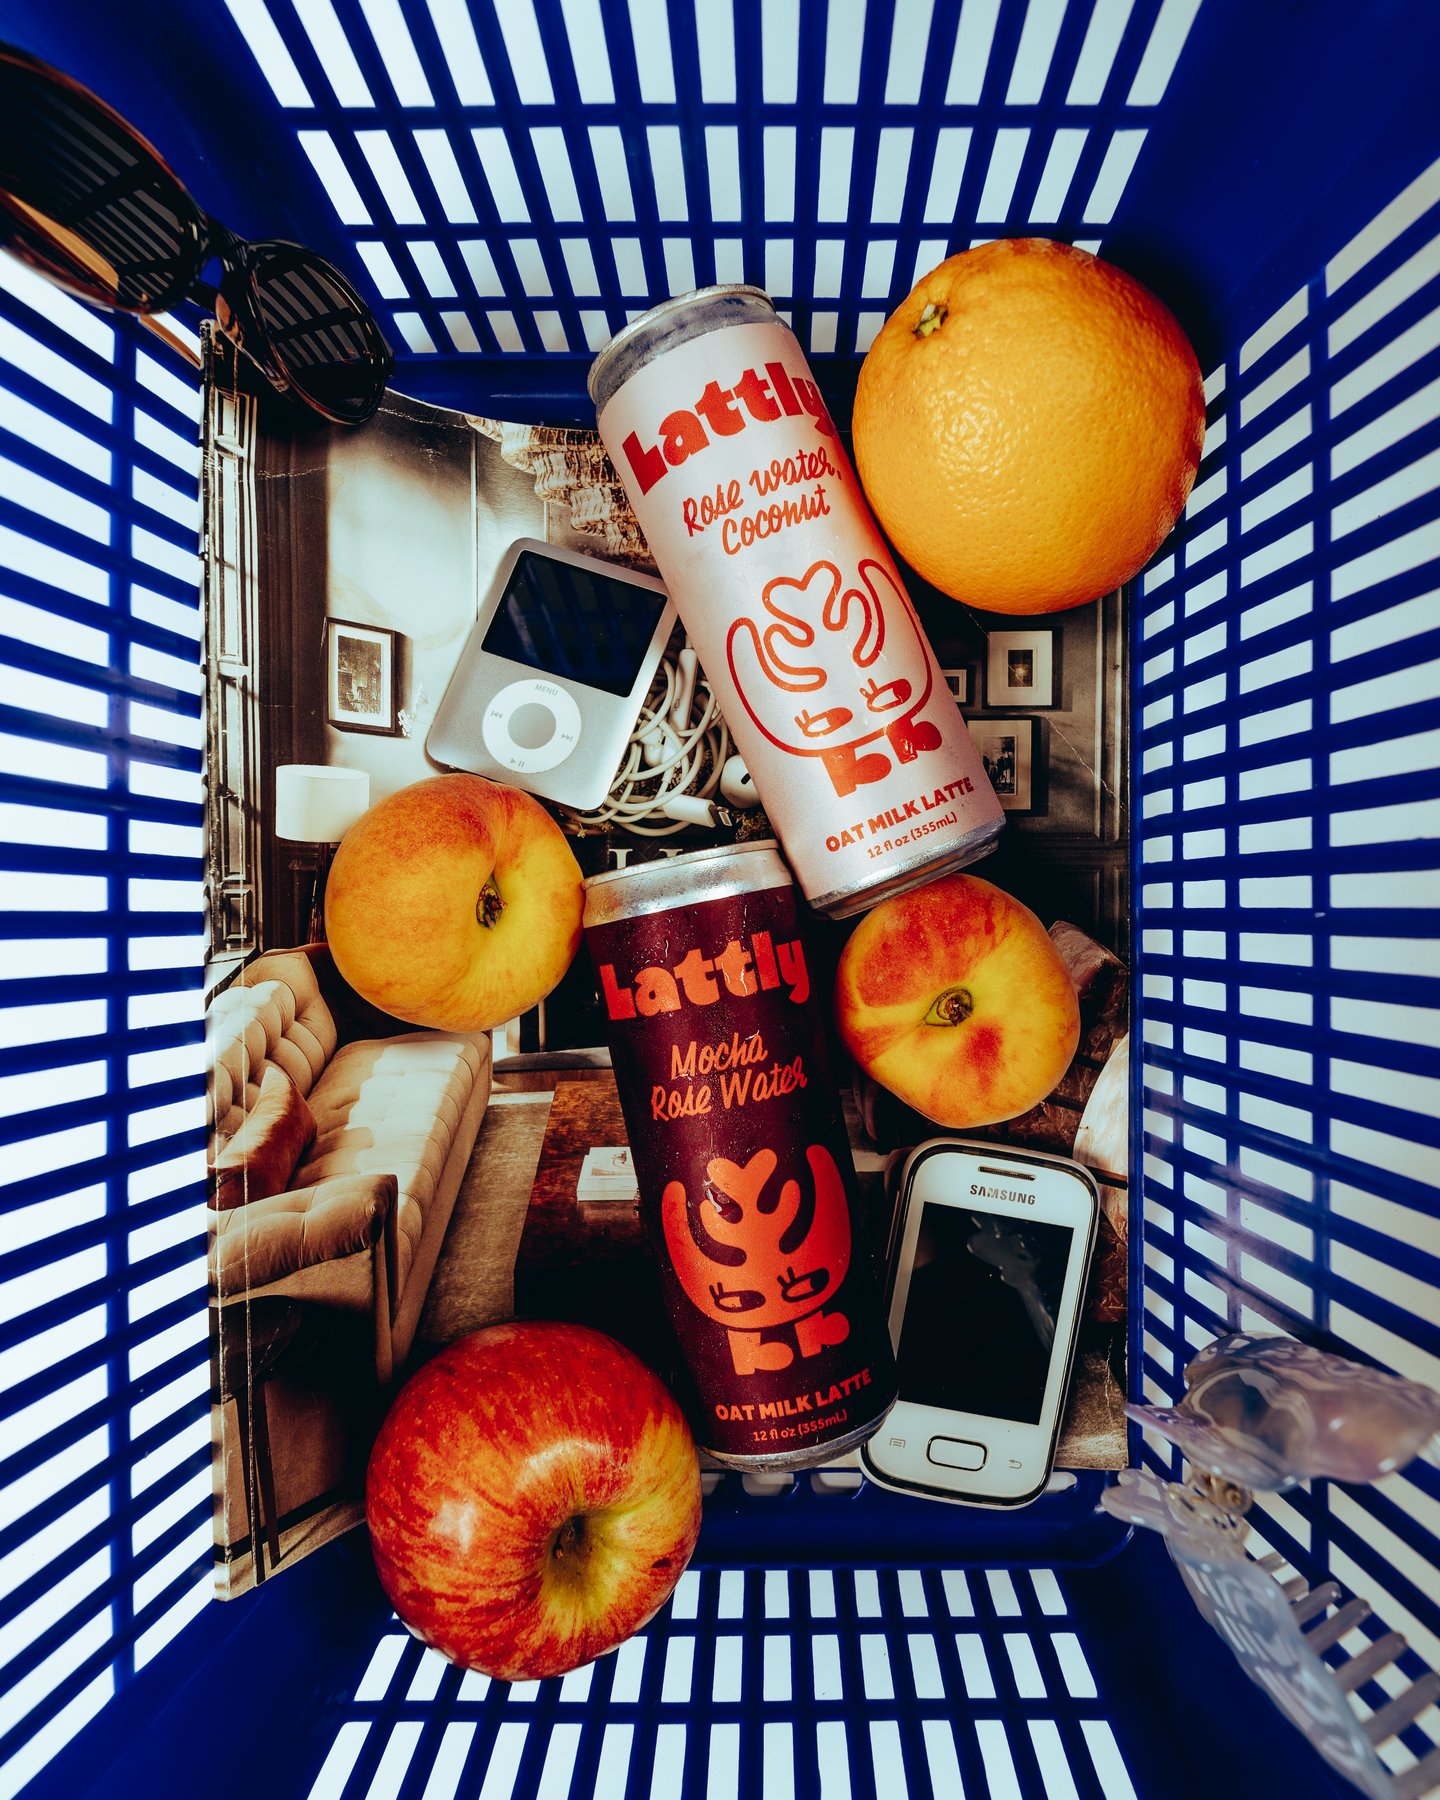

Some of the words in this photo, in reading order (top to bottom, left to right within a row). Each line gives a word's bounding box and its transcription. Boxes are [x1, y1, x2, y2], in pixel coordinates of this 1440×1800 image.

[621, 361, 836, 497] Lattly
[683, 480, 744, 537] Rose
[722, 484, 831, 556] Coconut
[535, 683, 559, 696] MENU
[825, 823, 865, 852] OAT
[867, 799, 922, 835] MILK
[920, 776, 975, 811] LATTE
[867, 845, 883, 860] 12
[883, 839, 894, 850] fl
[894, 835, 910, 847] oz
[910, 811, 959, 841] (355mL)
[600, 930, 811, 1021] Lattly
[671, 1031, 769, 1081] Mocha
[651, 1083, 714, 1122] Rose
[719, 1055, 808, 1110] Water
[969, 1184, 1037, 1206] SAMSUNG
[715, 1404, 755, 1422] OAT
[758, 1393, 814, 1420] MILK
[815, 1367, 872, 1408] LATTE
[752, 1430, 768, 1442] 12
[769, 1427, 779, 1440] fl
[780, 1427, 796, 1438] oz
[797, 1409, 848, 1437] (355mL)
